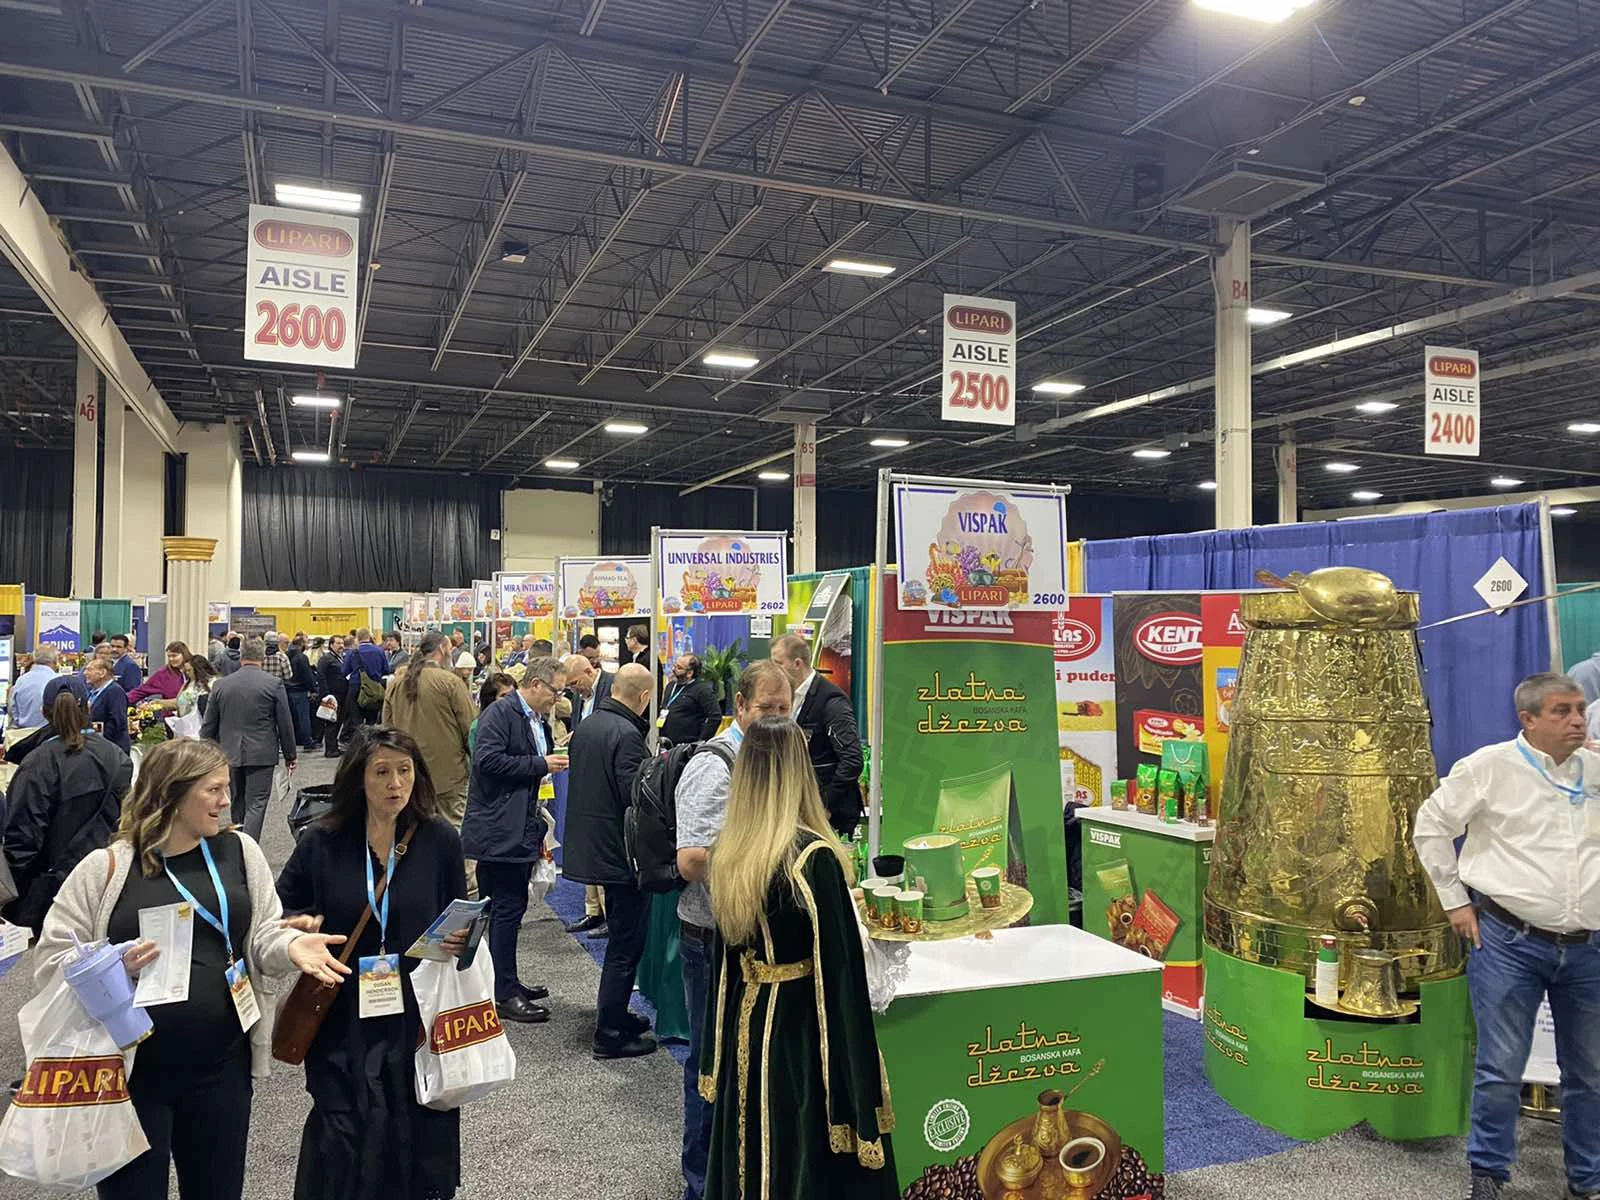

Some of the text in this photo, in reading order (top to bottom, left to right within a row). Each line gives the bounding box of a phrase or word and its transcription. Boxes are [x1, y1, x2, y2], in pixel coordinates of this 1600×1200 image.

[266, 227, 342, 250] LIPARI
[260, 266, 346, 293] AISLE
[1232, 280, 1249, 299] B4
[254, 300, 346, 352] 2600
[956, 311, 1005, 329] LIPARI
[952, 343, 1009, 364] AISLE
[1434, 361, 1472, 375] LIPARI
[949, 370, 1009, 412] 2500
[1433, 387, 1475, 404] AISLE
[1431, 412, 1475, 445] 2400
[958, 511, 1009, 534] VISPAK
[667, 552, 780, 565] UNIVERSAL INDUSTRIES
[503, 583, 520, 592] MIRA
[1490, 580, 1512, 592] 2600
[961, 590, 1003, 602] LIPARI
[1033, 593, 1065, 605] 2600
[706, 601, 738, 609] LIPARI
[760, 601, 785, 610] 2602
[927, 610, 1014, 626] VISPAK
[1052, 628, 1083, 642] LAS
[1147, 626, 1203, 643] KENT
[1067, 669, 1116, 683] puder
[918, 671, 1026, 703] zlatna
[1090, 830, 1121, 845] VISPAK
[967, 1020, 1081, 1057] zlatna
[1019, 1048, 1082, 1064] BOSANSKA KAFA
[1306, 1037, 1424, 1068] zlatna
[1361, 1070, 1425, 1079] BOSANSKA KAFA
